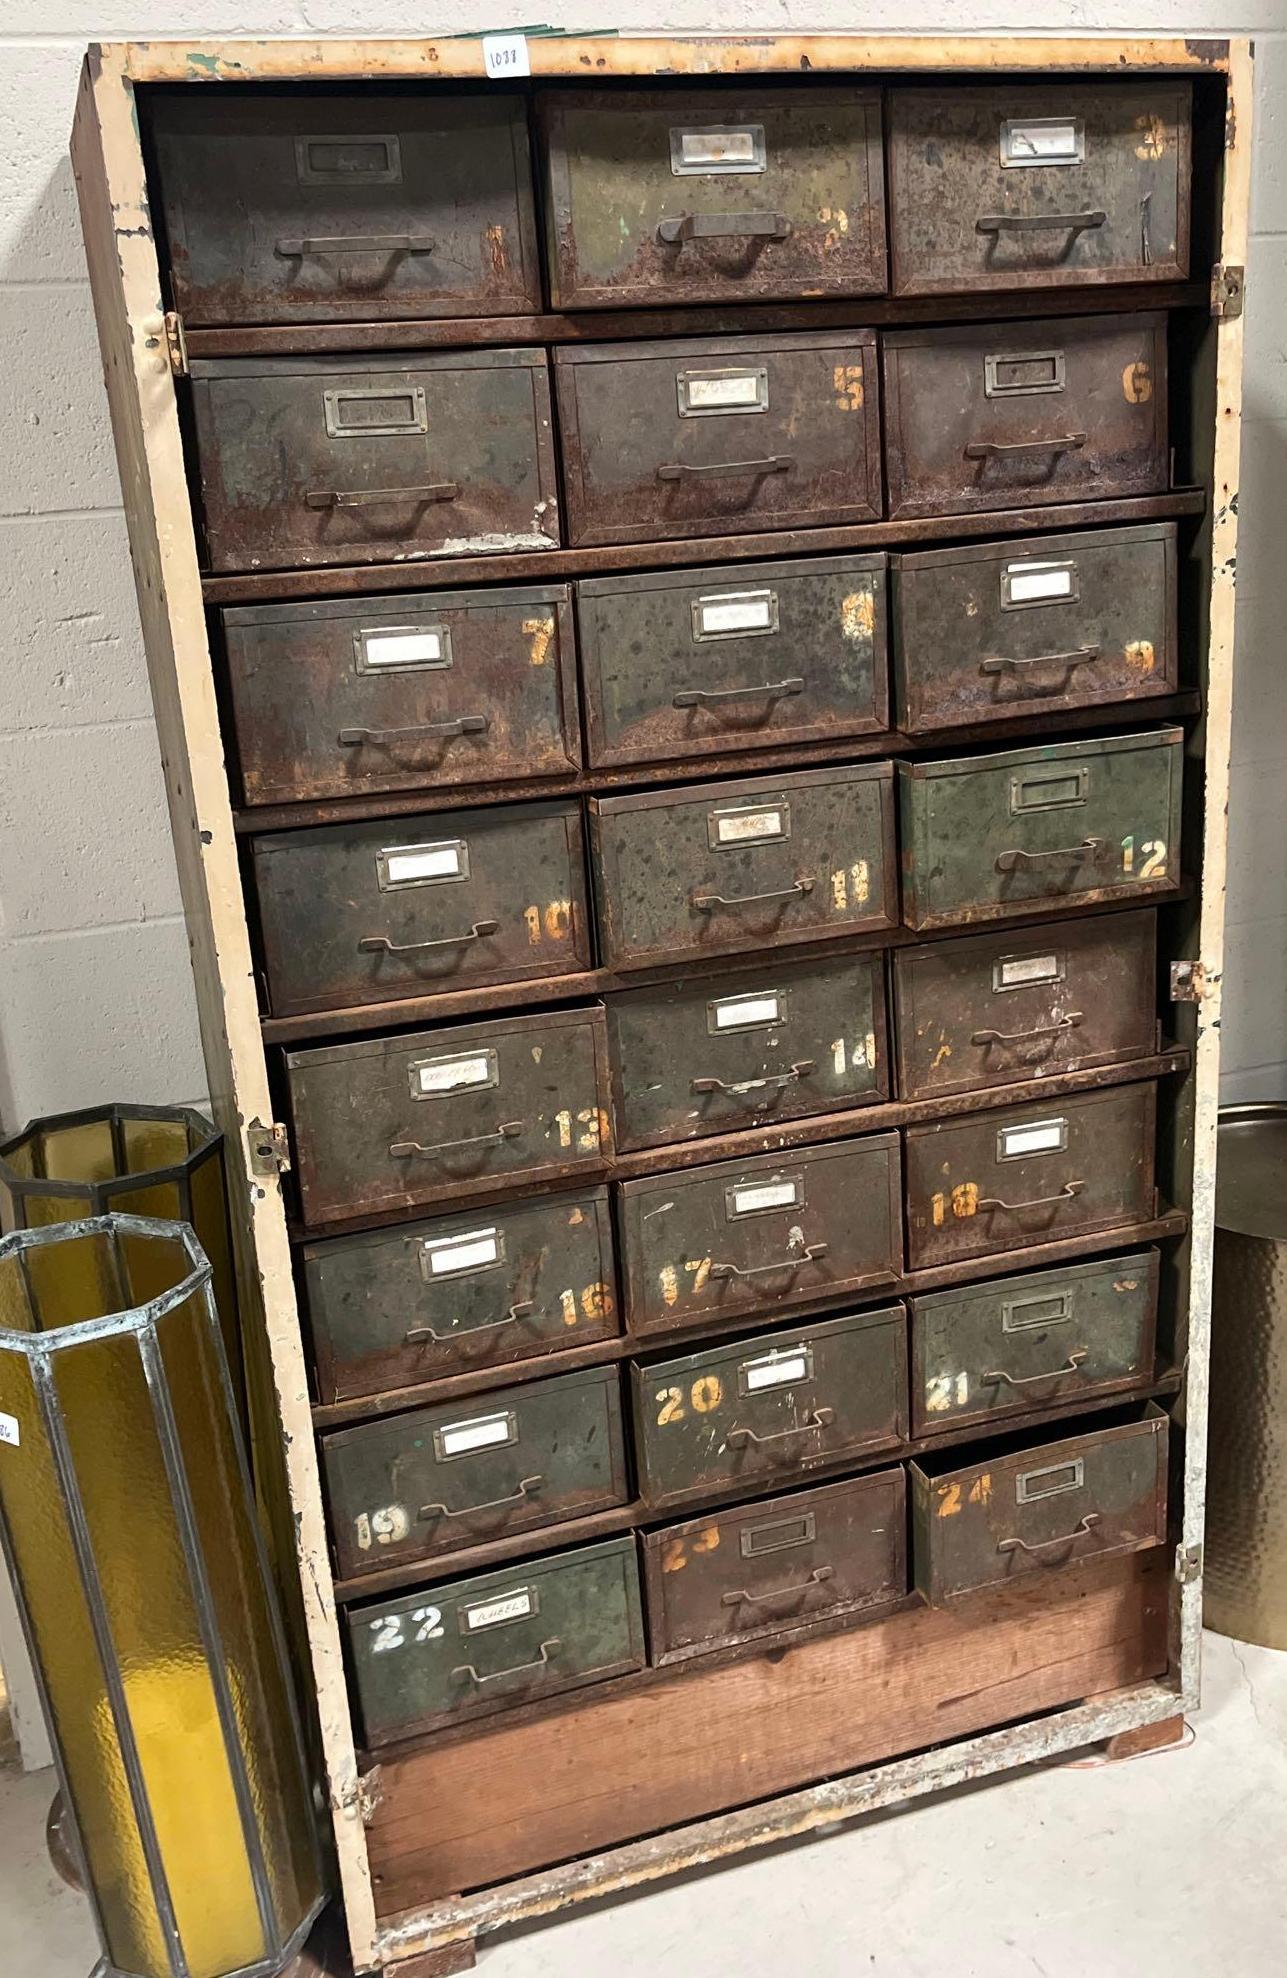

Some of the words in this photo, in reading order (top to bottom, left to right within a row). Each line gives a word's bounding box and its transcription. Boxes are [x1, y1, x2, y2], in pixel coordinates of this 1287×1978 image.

[833, 366, 864, 411] 5
[1122, 361, 1153, 404] 6
[521, 616, 555, 666] 7
[1120, 834, 1167, 878] 12
[523, 900, 573, 946] 10
[655, 1375, 723, 1426] 20
[368, 1605, 445, 1654] 22
